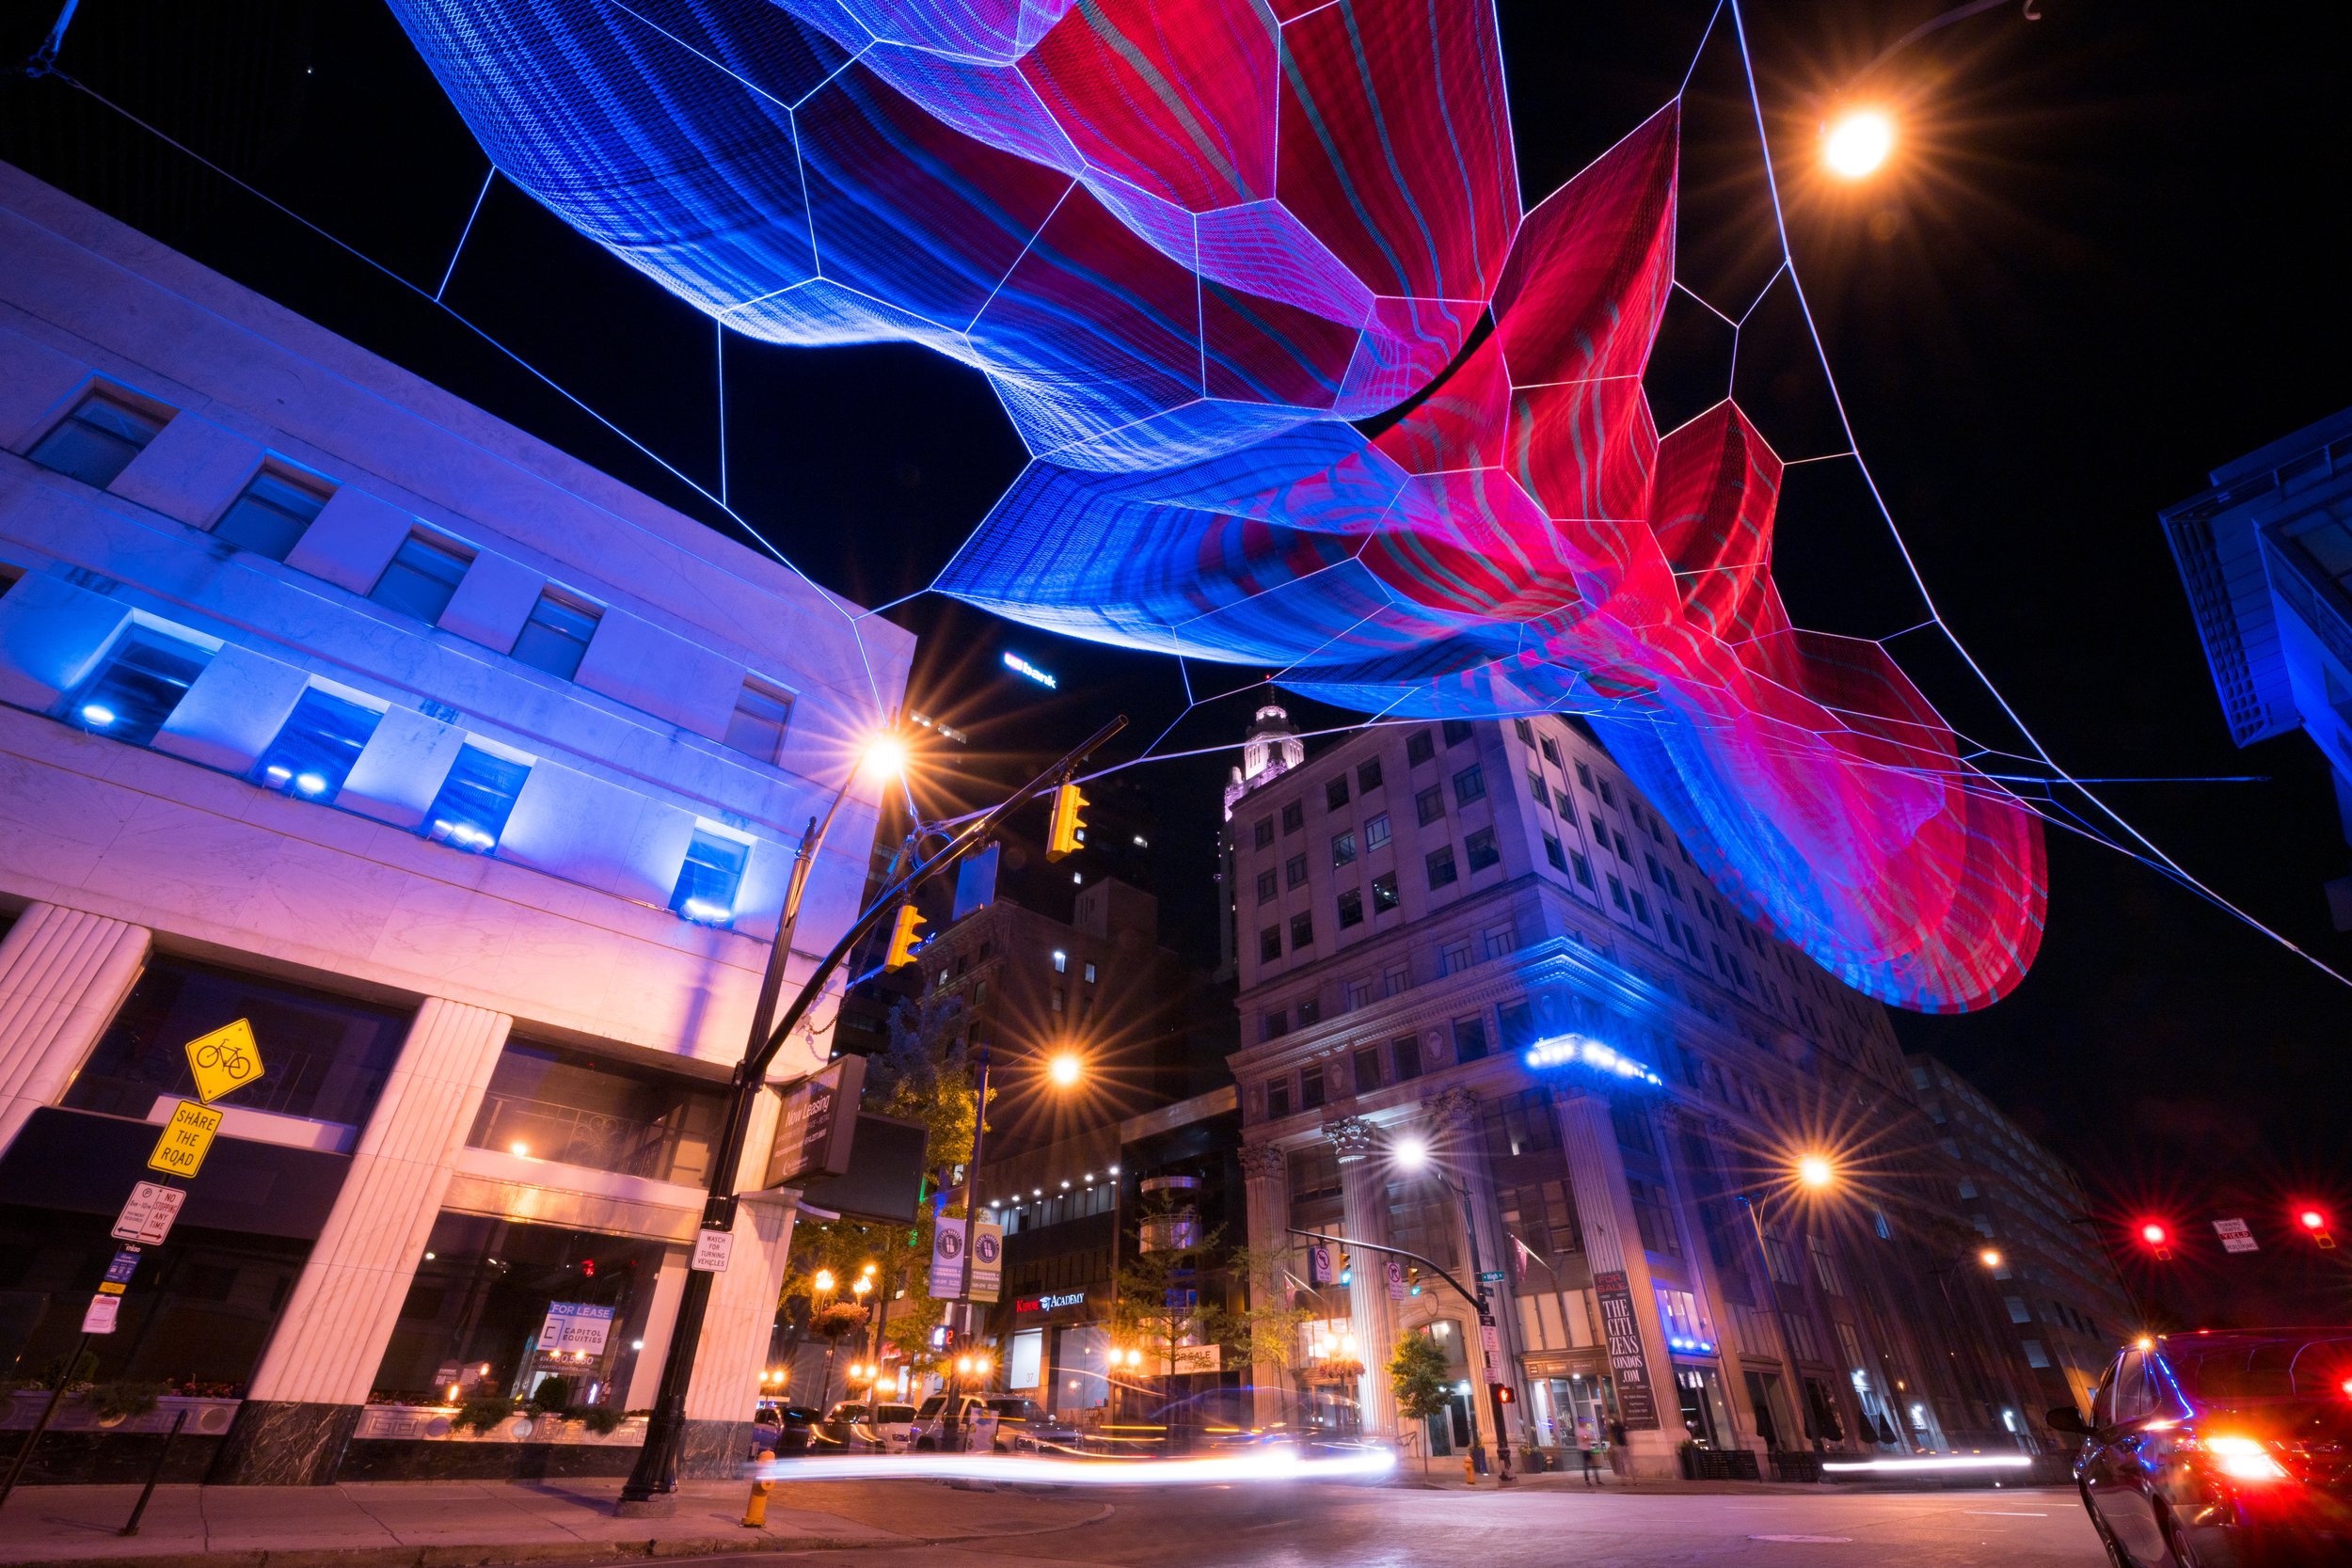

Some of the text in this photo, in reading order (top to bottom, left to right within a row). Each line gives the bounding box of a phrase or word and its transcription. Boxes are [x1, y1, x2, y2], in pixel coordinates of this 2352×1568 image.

[1023, 662, 1056, 689] bank
[786, 1095, 830, 1127] Now Leasing
[177, 1110, 215, 1131] SHARE
[176, 1130, 199, 1147] THE
[161, 1148, 194, 1165] ROAD
[165, 1193, 176, 1202] NO
[154, 1212, 169, 1221] ANY
[150, 1221, 166, 1230] TIME
[701, 1250, 725, 1259] TURNING
[697, 1259, 724, 1267] VEHICLES
[1599, 1275, 1621, 1283] FOR
[1597, 1283, 1626, 1292] SALE
[1051, 1292, 1084, 1307] ACADEMY
[552, 1304, 611, 1318] FOR LEASE
[1603, 1299, 1629, 1318] THE
[564, 1327, 601, 1337] CAPITOL
[1608, 1317, 1632, 1336] CITI
[563, 1335, 602, 1344] EQUITIES
[1610, 1336, 1639, 1354] ZENS
[1613, 1355, 1643, 1369] CONDOS
[1026, 1373, 1034, 1383] 37
[1623, 1370, 1640, 1383] .COM
